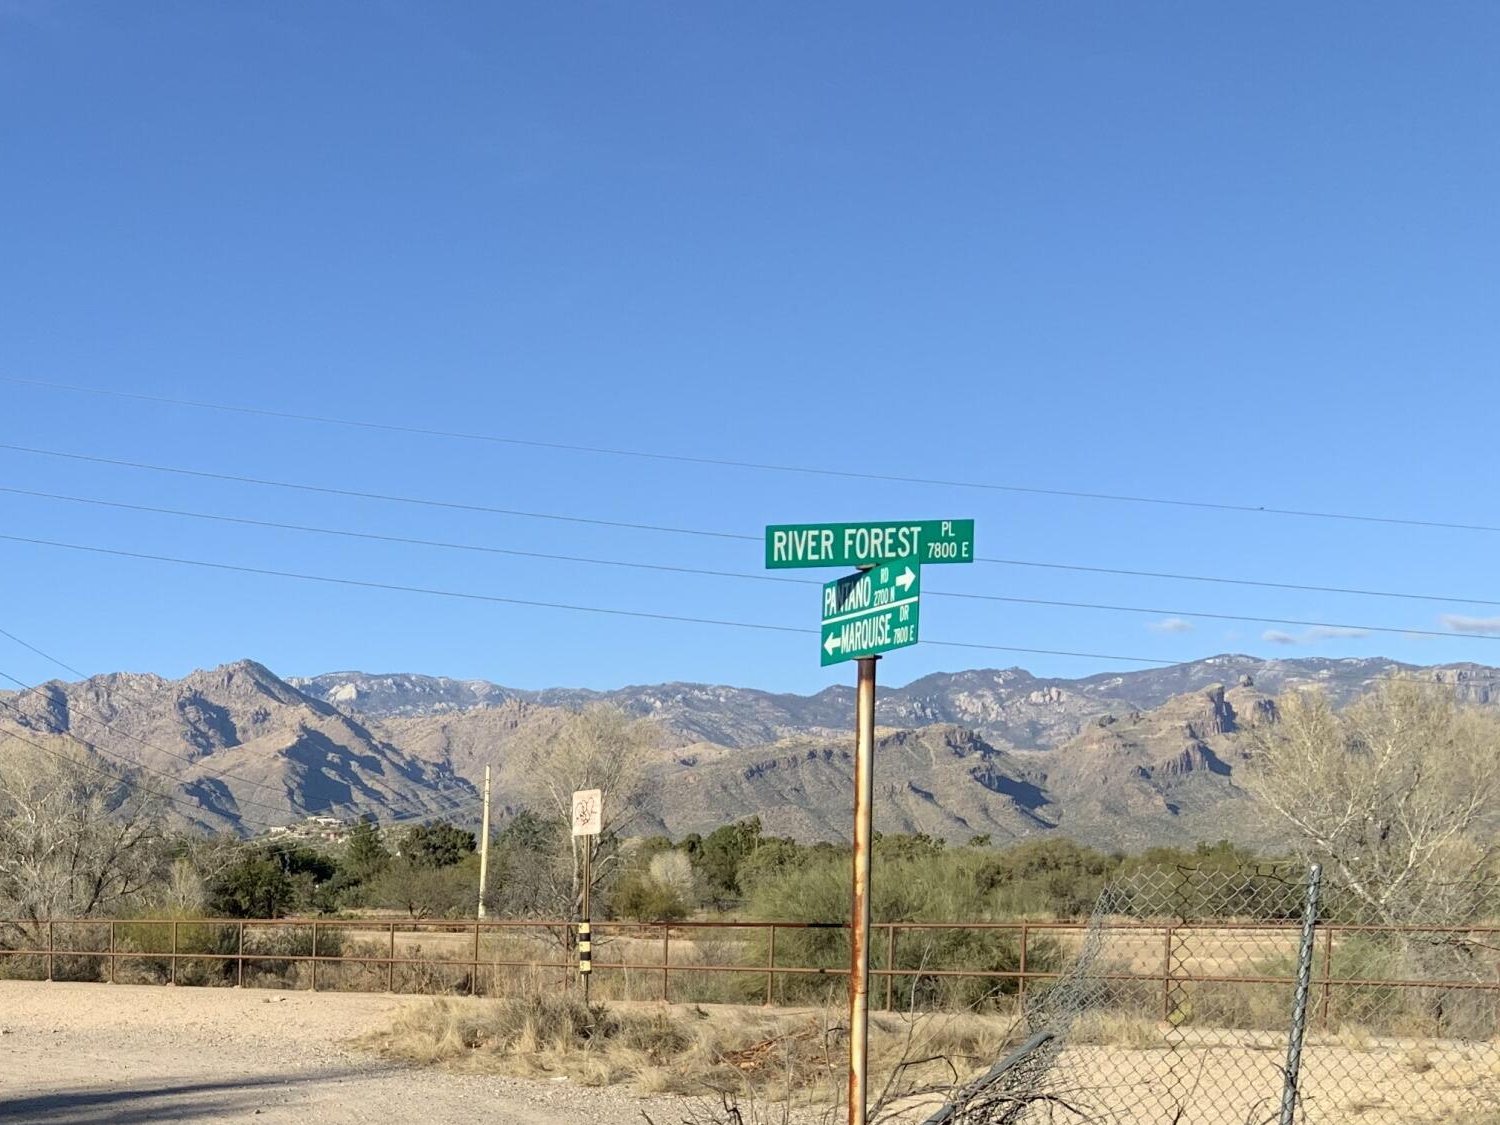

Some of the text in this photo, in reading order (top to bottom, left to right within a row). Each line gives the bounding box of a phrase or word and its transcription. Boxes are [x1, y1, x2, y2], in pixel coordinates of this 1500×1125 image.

[941, 521, 956, 537] PL
[773, 526, 922, 562] RIVER FOREST
[927, 541, 969, 559] 7800 E
[880, 567, 889, 584] RD
[824, 576, 872, 617] PANTANO
[899, 605, 910, 622] DR
[841, 613, 892, 654] MARQUISE
[909, 625, 915, 642] E
